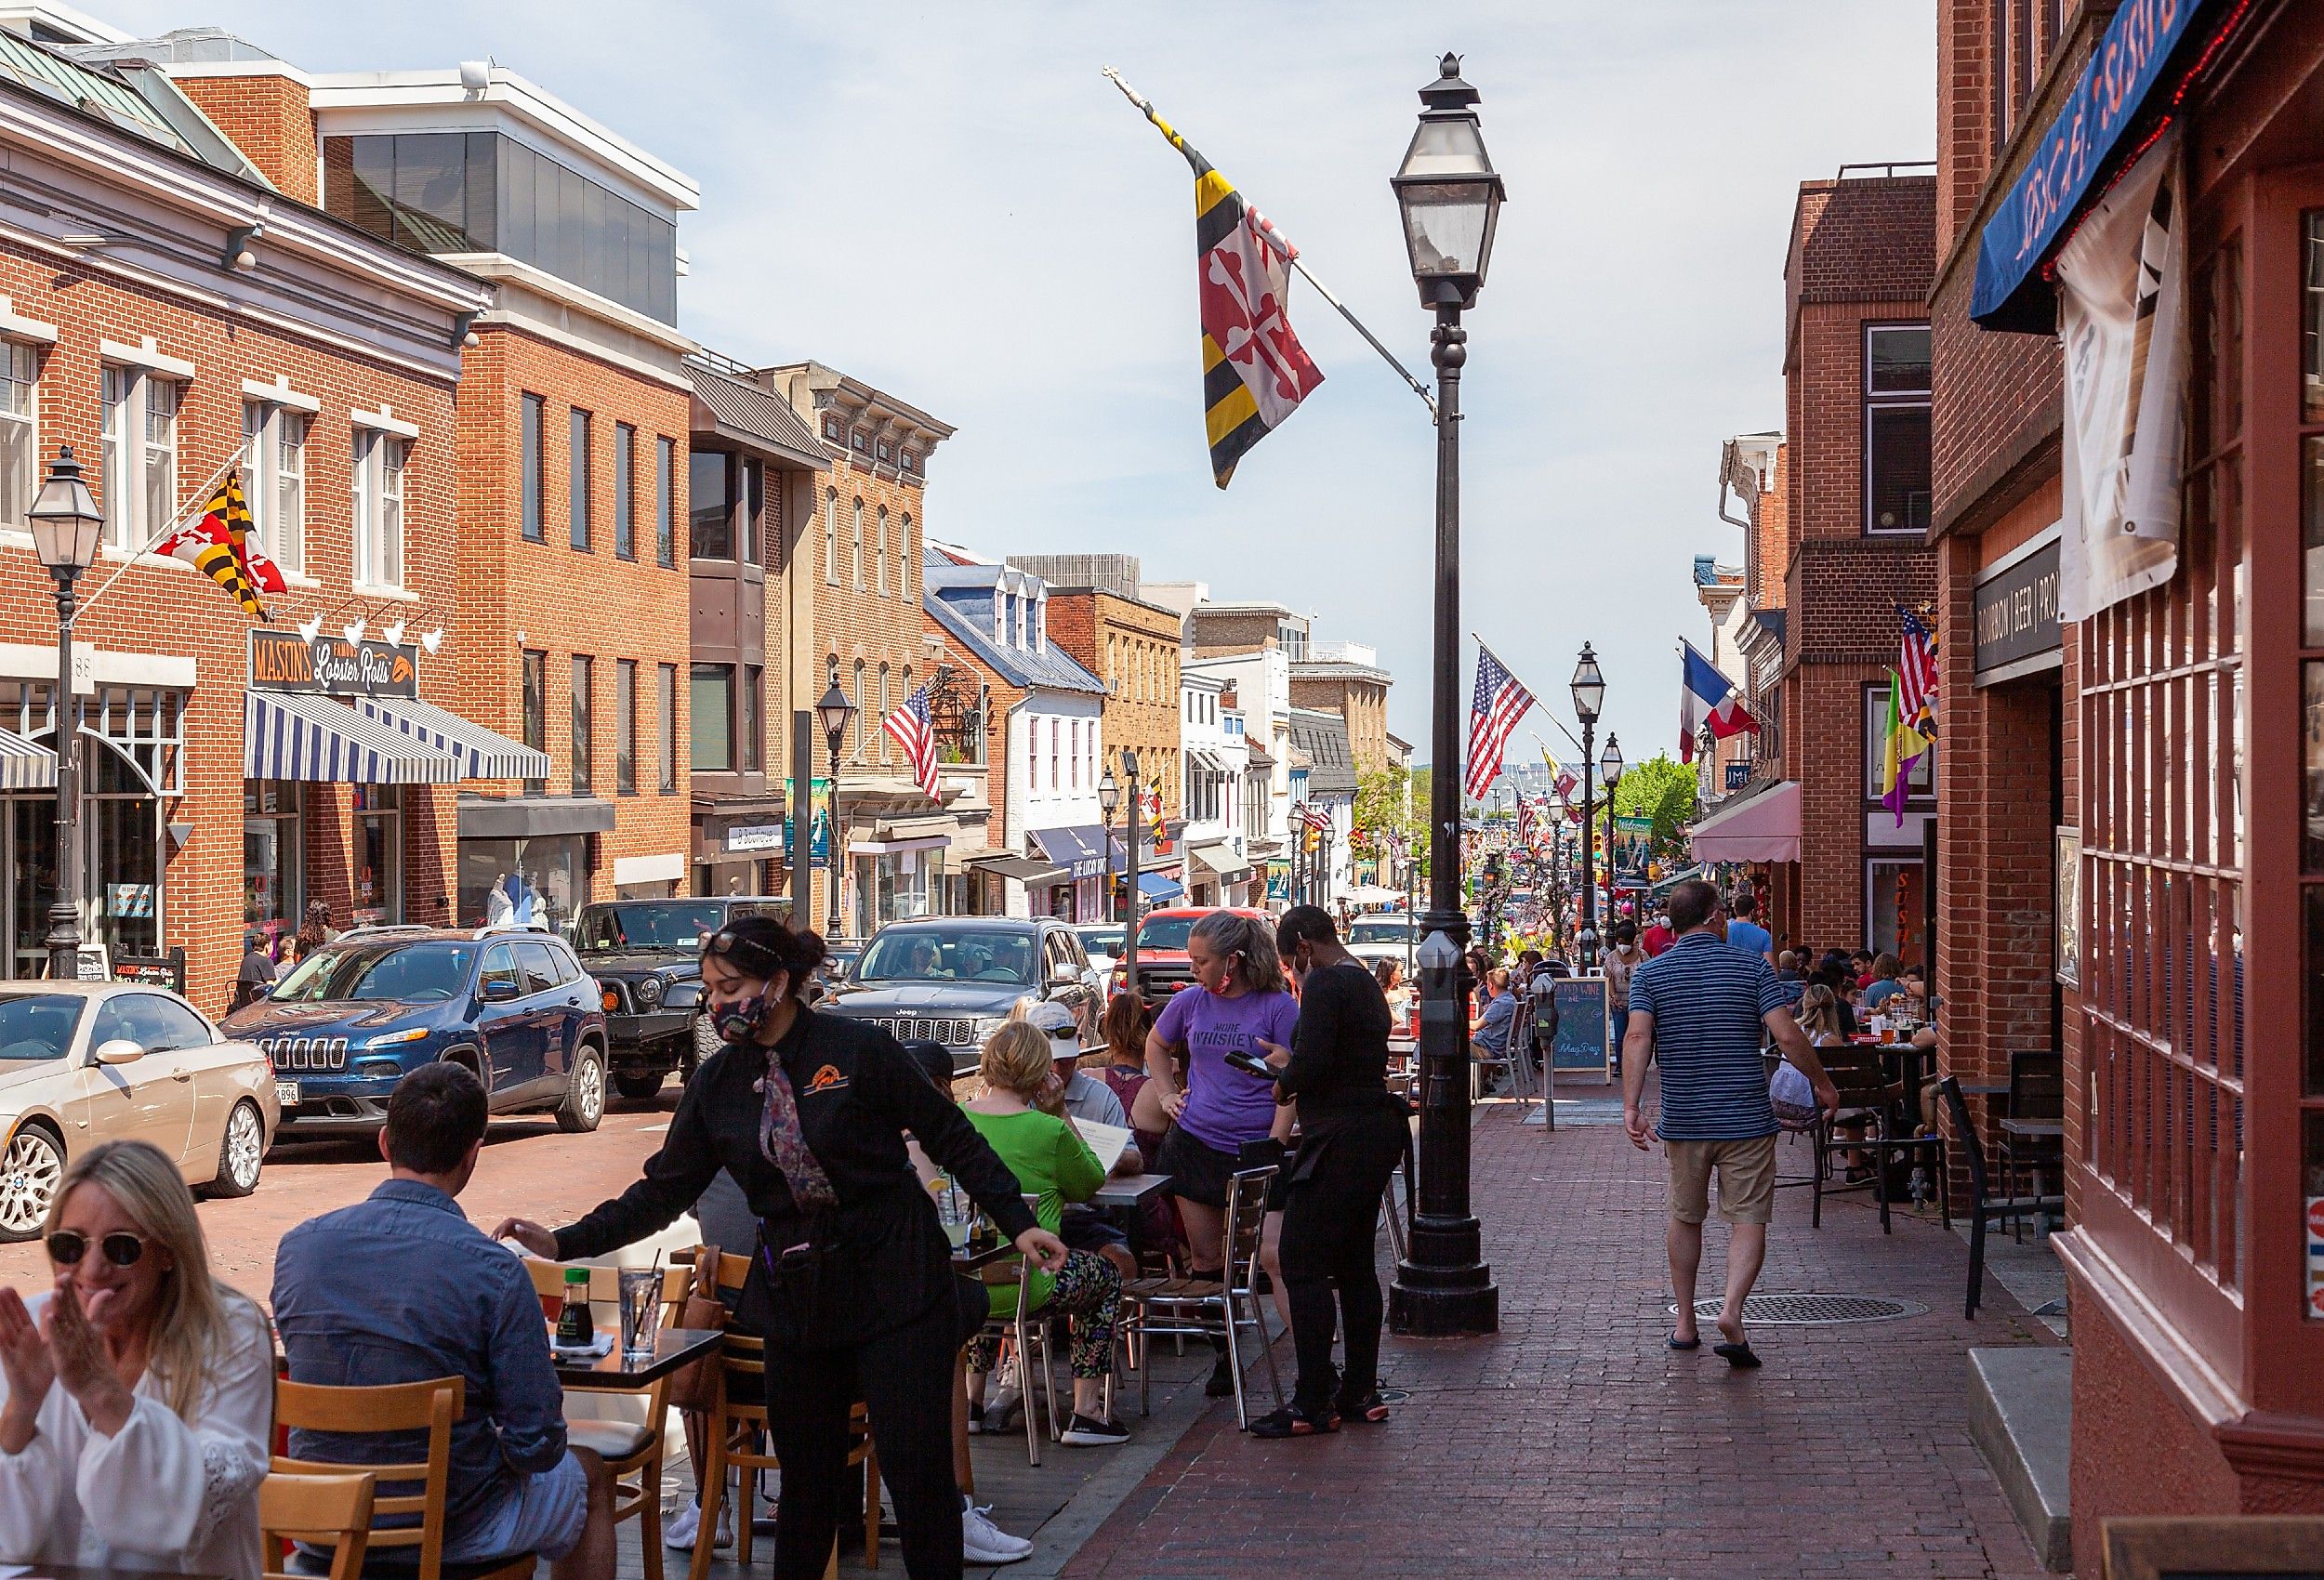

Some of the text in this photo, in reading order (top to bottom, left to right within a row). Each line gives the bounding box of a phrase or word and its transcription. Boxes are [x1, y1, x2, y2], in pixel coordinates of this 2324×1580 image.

[1978, 598, 2009, 647] BOURBON
[2014, 586, 2033, 632] BEER
[71, 657, 90, 678] 88
[313, 643, 360, 689] Lobster
[360, 646, 390, 691] Rolls
[1073, 861, 1083, 878] THE
[1097, 856, 1107, 875] KNO
[1213, 1022, 1241, 1034] MORE
[1194, 1032, 1256, 1048] WHISKEY
